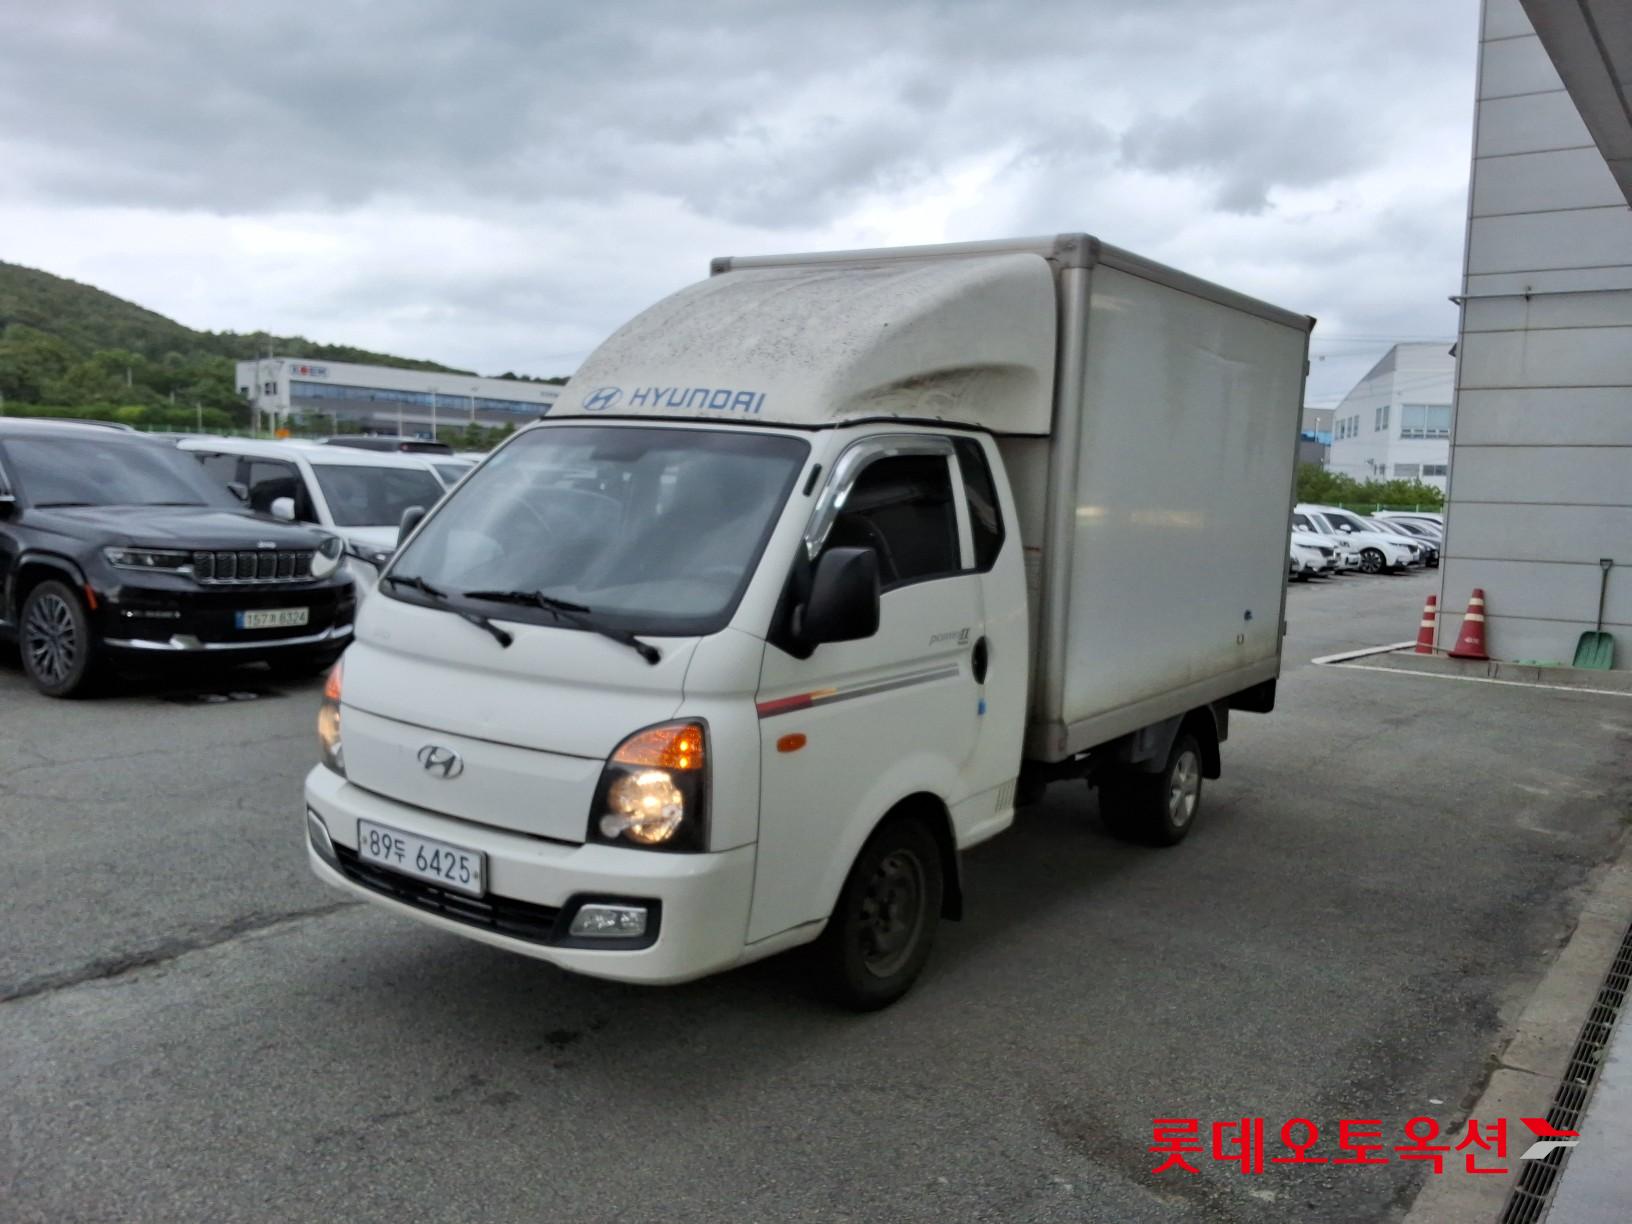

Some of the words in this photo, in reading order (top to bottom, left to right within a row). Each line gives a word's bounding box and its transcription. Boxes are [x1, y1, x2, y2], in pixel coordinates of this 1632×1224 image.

[628, 386, 767, 414] HYUNDAI
[369, 829, 406, 864] 89두
[415, 844, 471, 884] 6425
